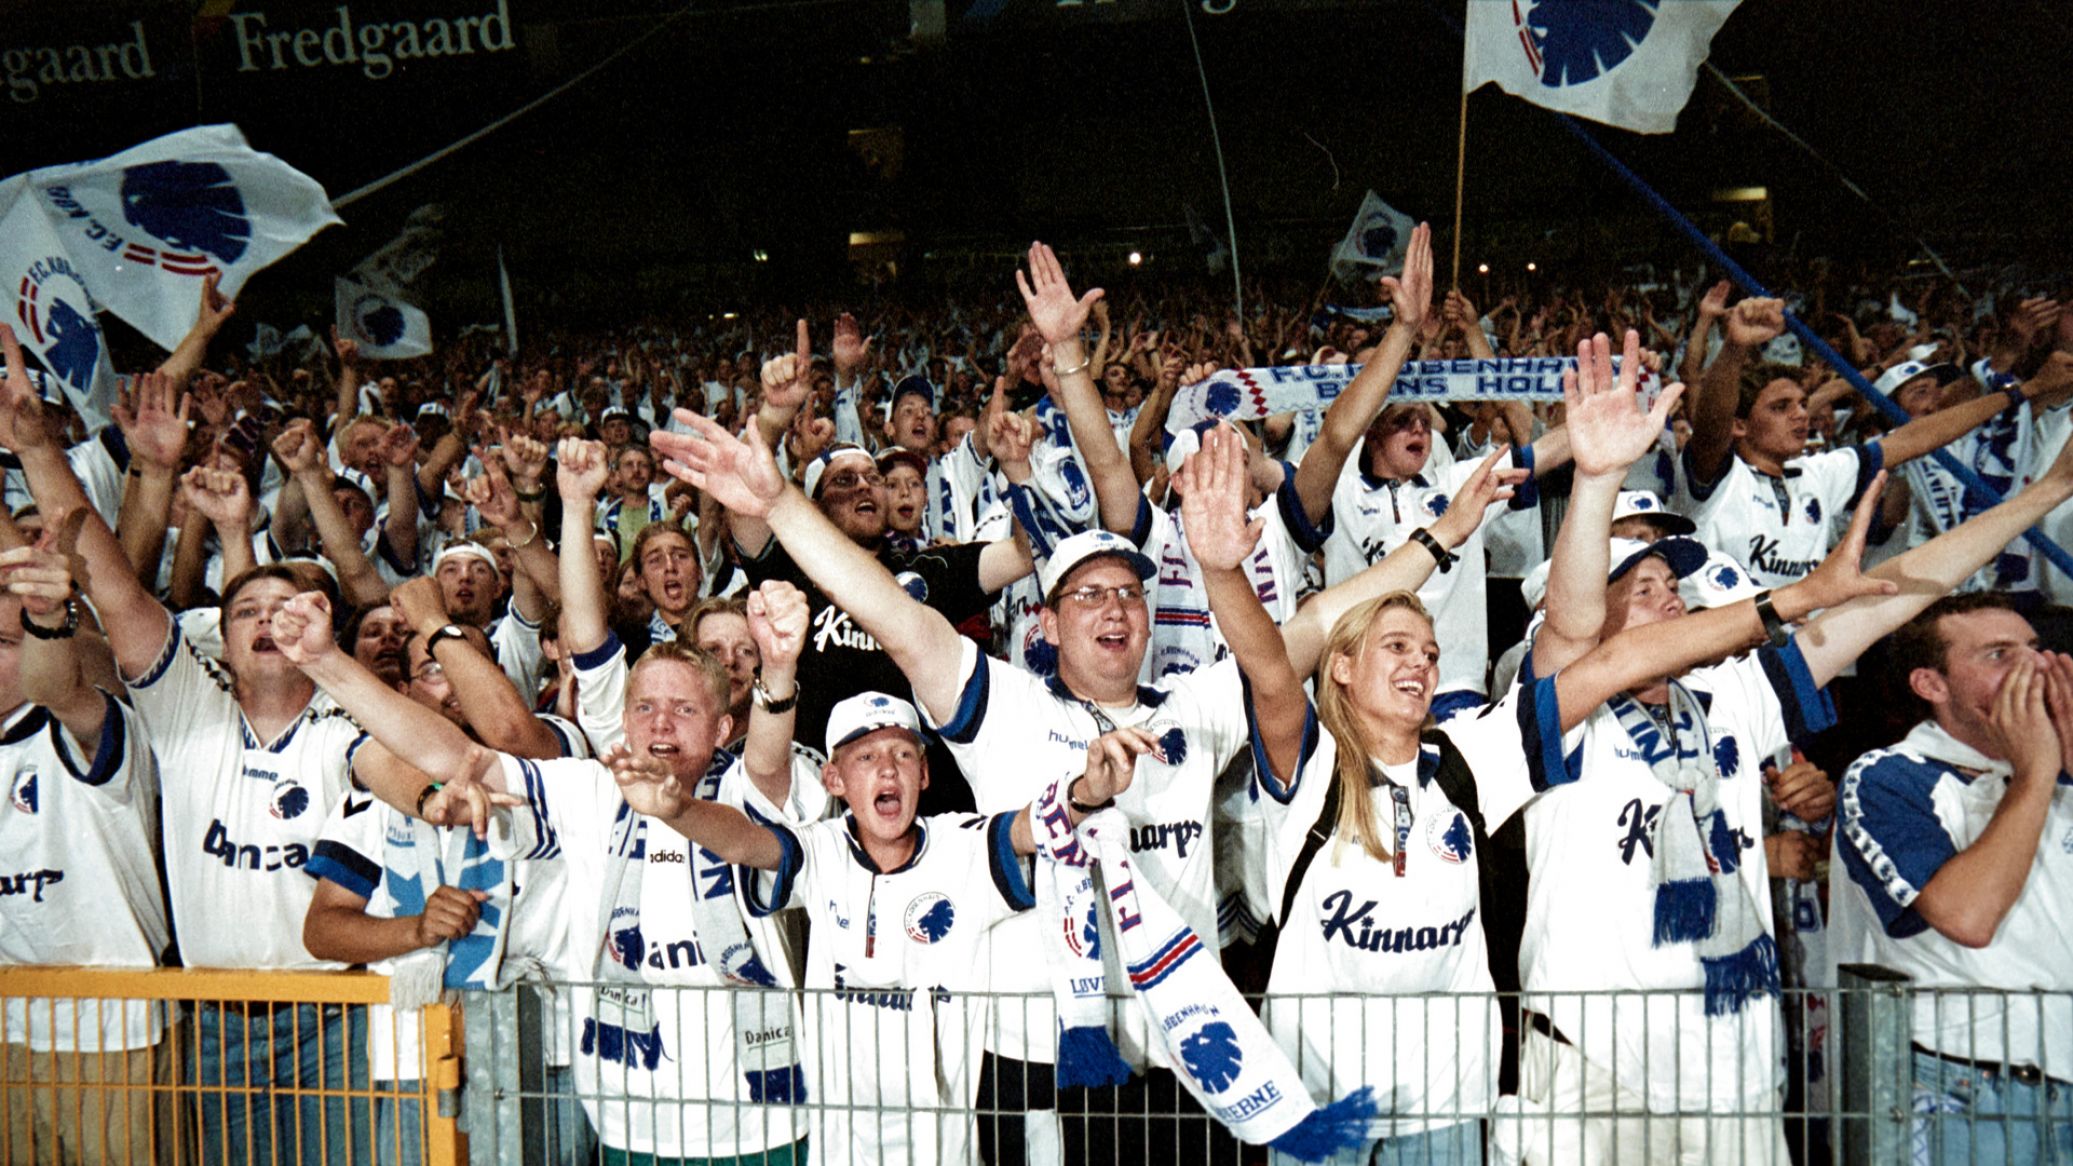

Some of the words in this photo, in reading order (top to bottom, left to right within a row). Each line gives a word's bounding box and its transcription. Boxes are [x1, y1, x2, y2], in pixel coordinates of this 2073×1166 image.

[1, 20, 156, 103] gaard
[229, 0, 516, 80] Fredgaard
[202, 818, 310, 872] Danca
[601, 985, 640, 1006] Danca
